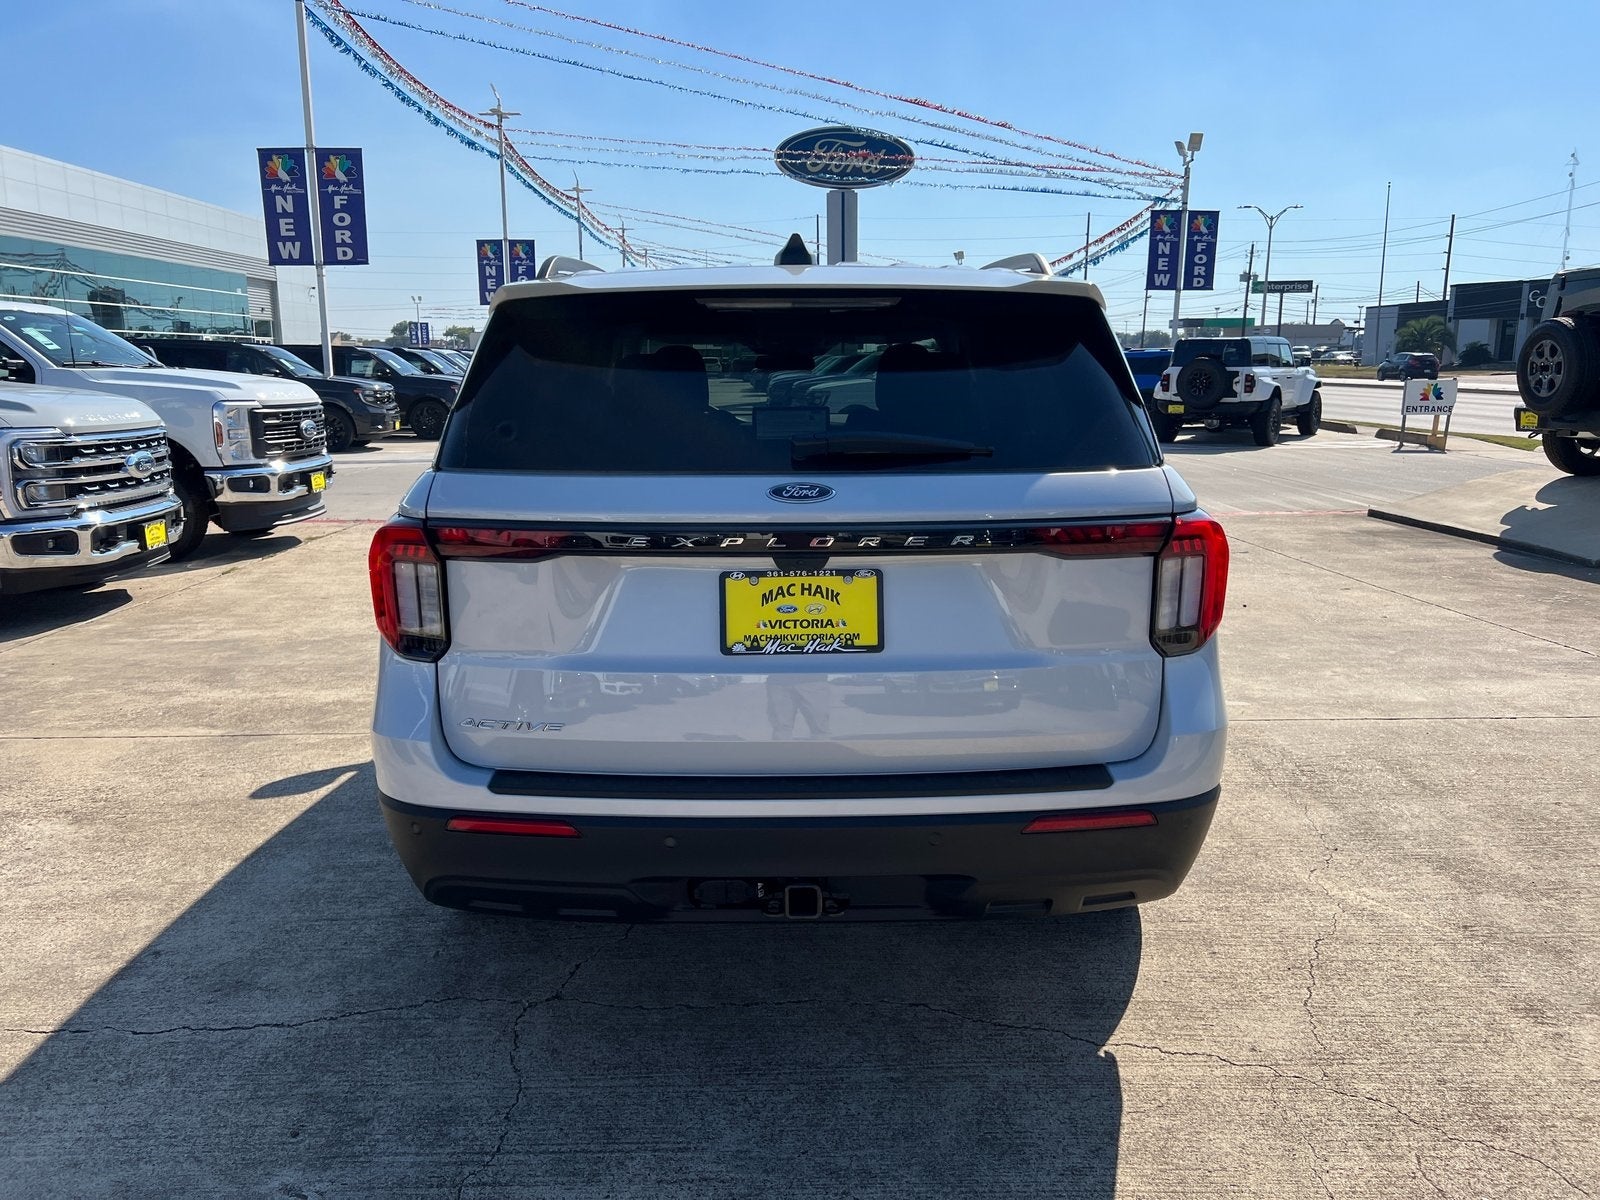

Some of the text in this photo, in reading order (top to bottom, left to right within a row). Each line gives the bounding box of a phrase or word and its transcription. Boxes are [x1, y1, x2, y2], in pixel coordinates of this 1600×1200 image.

[805, 139, 886, 174] Ford
[275, 195, 301, 260] NEW
[332, 195, 354, 261] FORD
[1154, 242, 1171, 286] NEW
[1193, 242, 1208, 288] FORD
[485, 265, 497, 302] NEW
[1405, 405, 1454, 413] ENTRANCE
[782, 485, 820, 497] Ford
[625, 535, 975, 548] EXPLORER
[761, 583, 841, 607] MAC HAIK
[768, 619, 835, 630] VICTORIA
[743, 633, 860, 642] MACHAIKVICTORIA.COM
[762, 638, 843, 654] Mac Haik
[459, 717, 565, 731] ACTIVE
